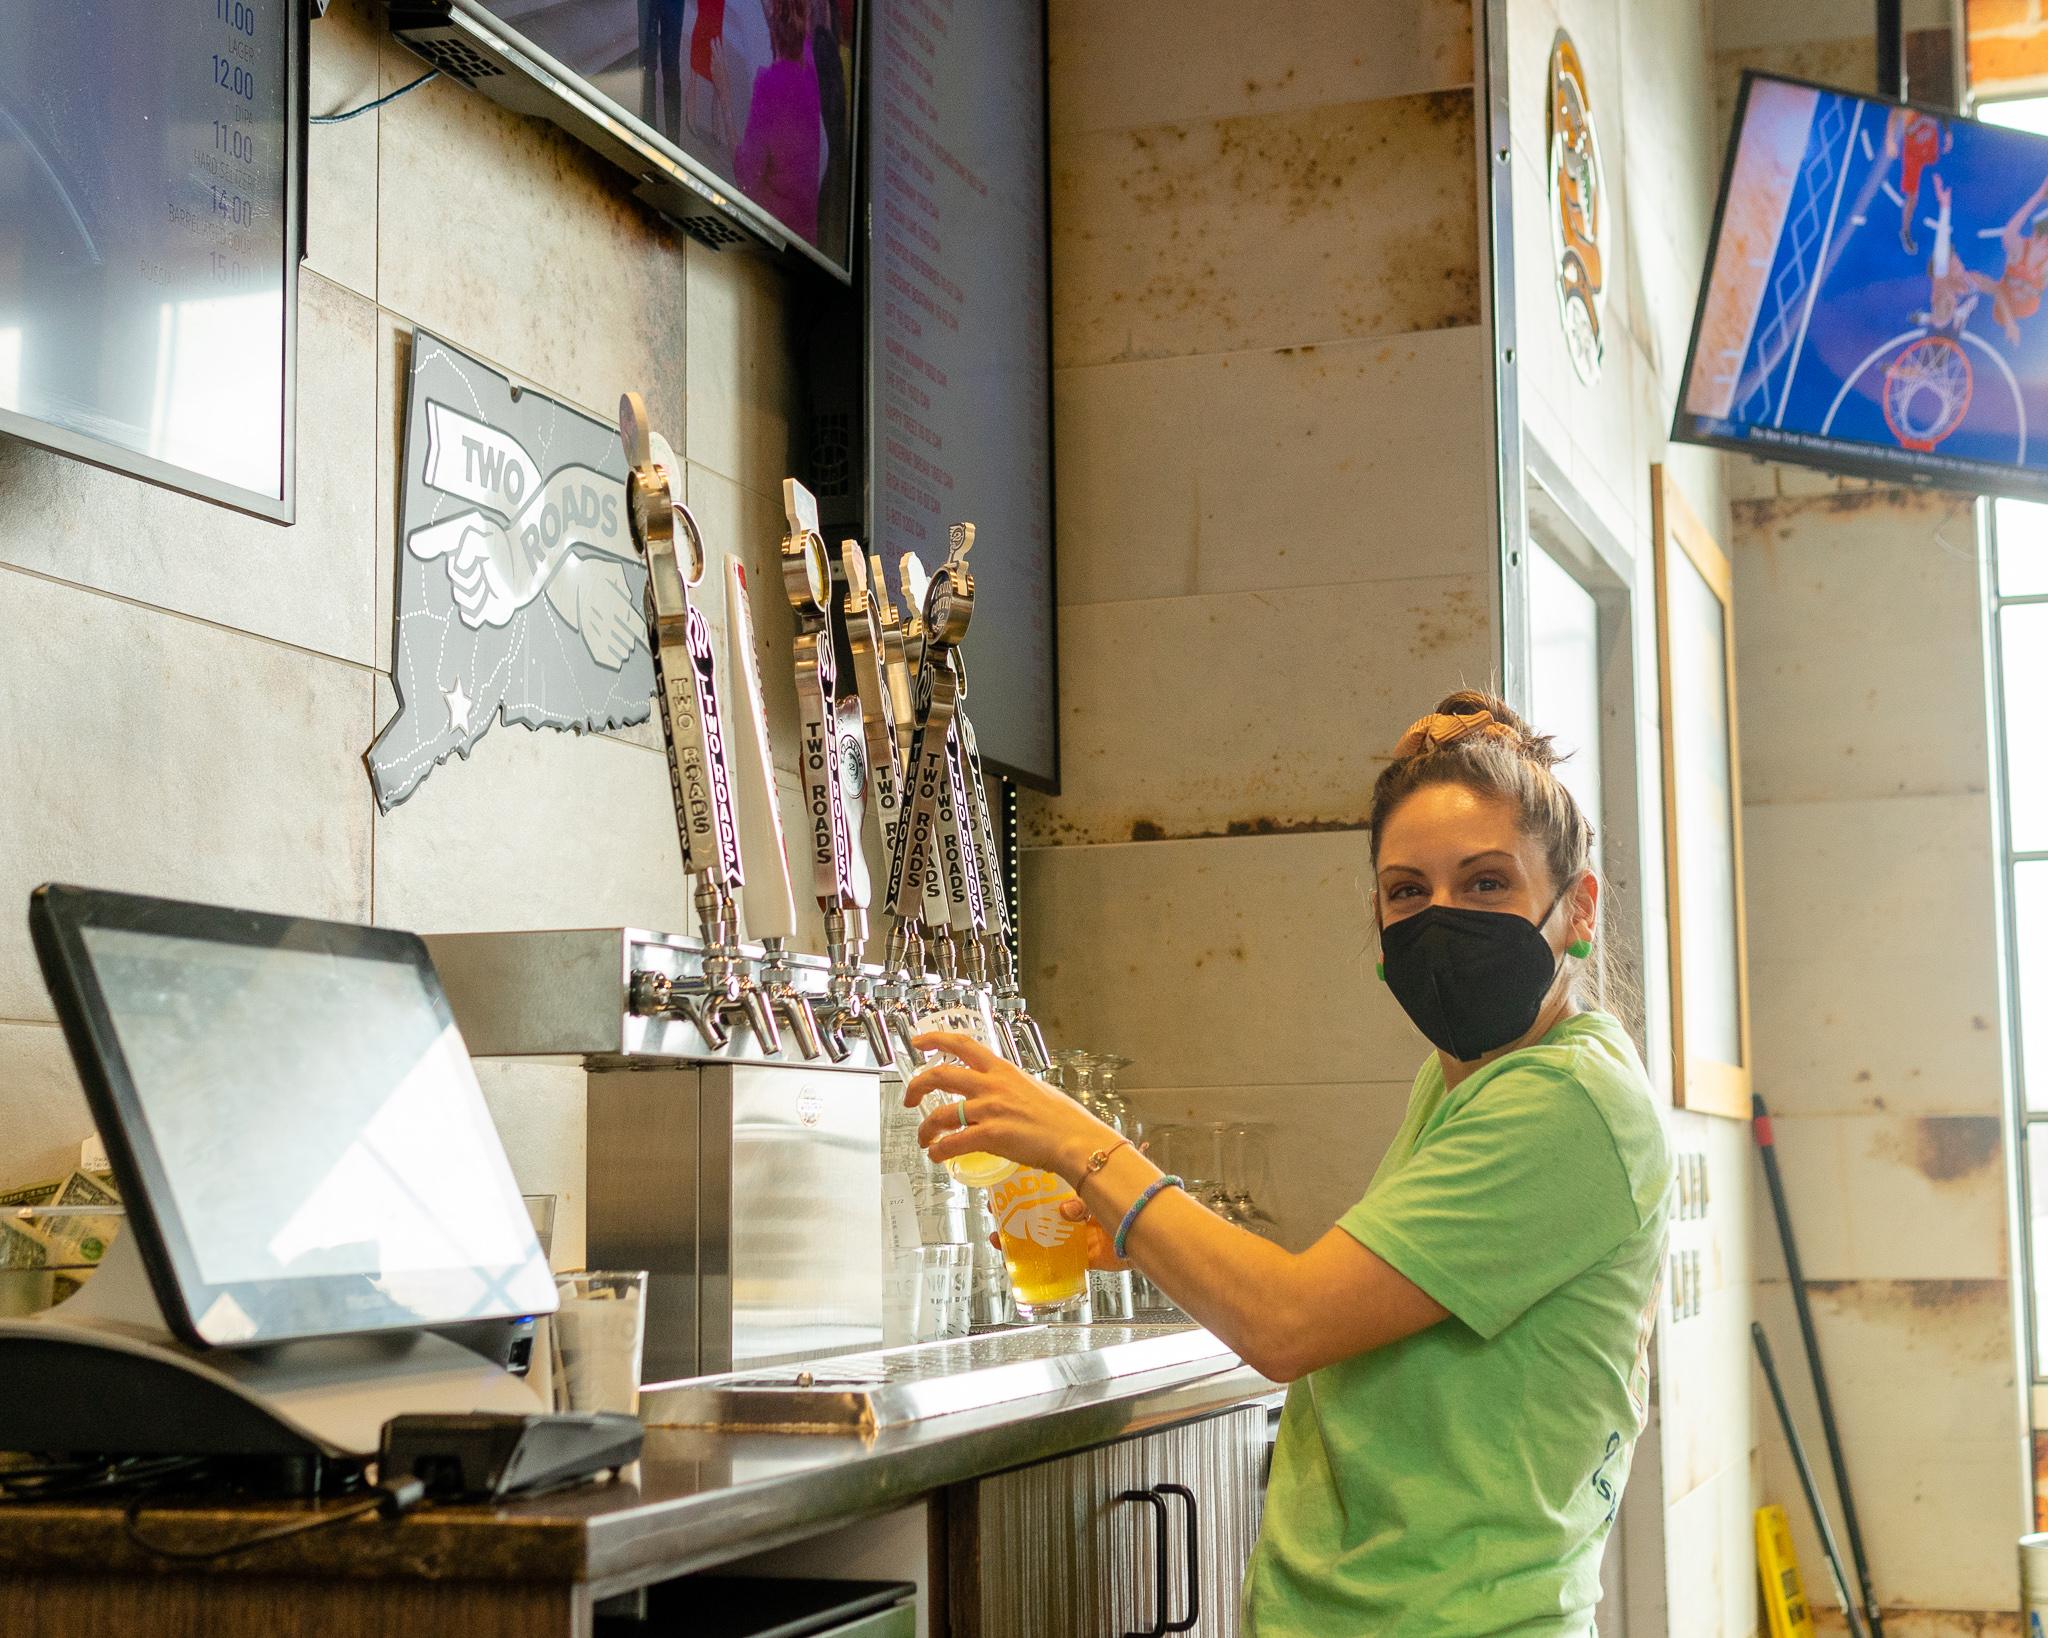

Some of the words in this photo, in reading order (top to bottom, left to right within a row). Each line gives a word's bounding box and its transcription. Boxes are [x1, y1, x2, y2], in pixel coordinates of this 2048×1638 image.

[212, 54, 253, 100] 12.00
[213, 120, 252, 164] 11.00
[461, 435, 525, 506] TWO
[519, 484, 618, 575] ROADS
[671, 677, 695, 730] TWO
[683, 747, 710, 834] ROADS
[703, 695, 720, 754] TWO
[713, 763, 736, 862] ROADS
[806, 722, 823, 770] TWO
[906, 743, 921, 797] TWO
[920, 753, 940, 798] TWO
[876, 765, 895, 809] TWO
[937, 780, 953, 822] TWO
[812, 785, 831, 864] ROADS
[832, 781, 847, 876] ROADS
[890, 806, 911, 895] ROADS
[907, 812, 930, 887] ROADS
[953, 772, 966, 821] TWO
[961, 829, 979, 911] ROADS
[944, 835, 965, 903] ROADS
[994, 1171, 1057, 1212] OADS
